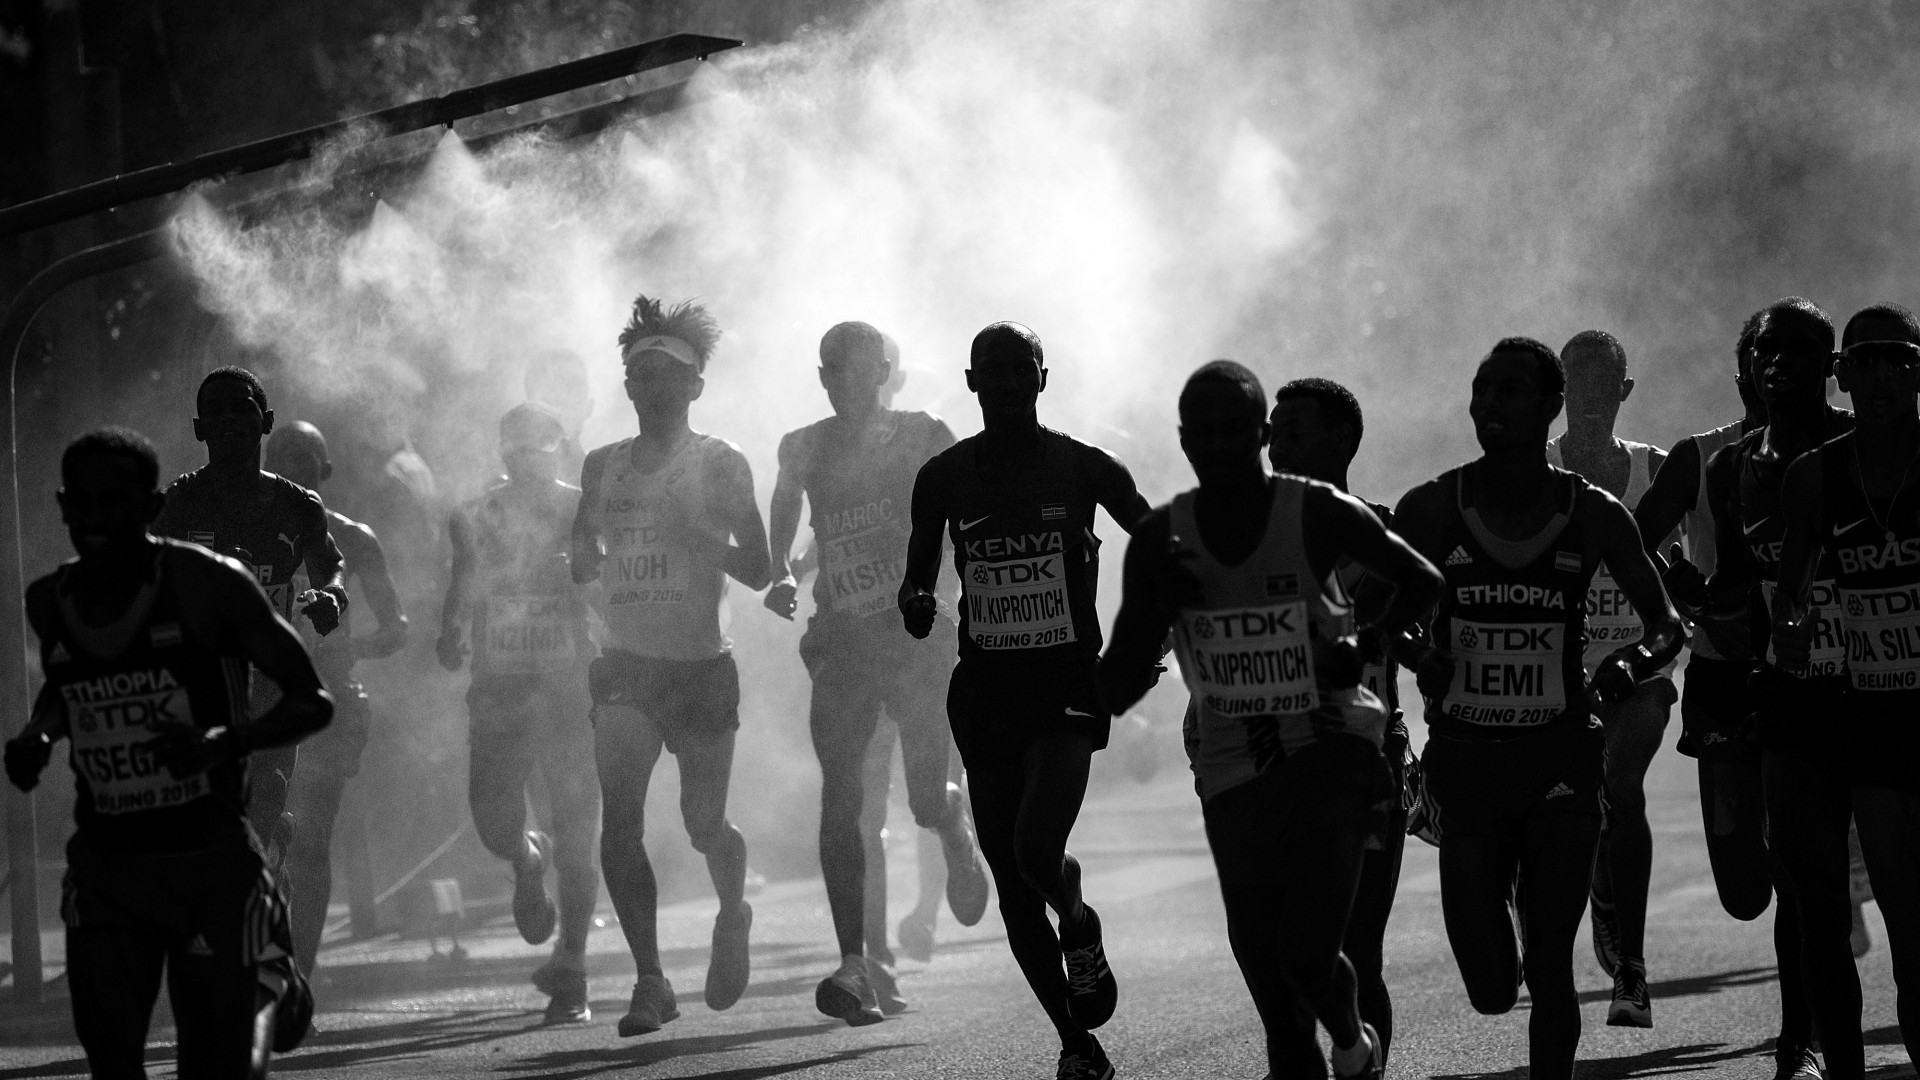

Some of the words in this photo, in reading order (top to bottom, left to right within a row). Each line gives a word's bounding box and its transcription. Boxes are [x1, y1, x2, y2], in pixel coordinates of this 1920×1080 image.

[964, 531, 1063, 559] KENYA
[617, 555, 667, 581] NOH
[987, 559, 1056, 586] TDK
[652, 589, 684, 602] 2015
[1456, 583, 1565, 610] ETHIOPIA
[975, 633, 1031, 648] BEIJING
[1035, 626, 1068, 645] 2015
[1213, 609, 1295, 638] TDK
[490, 624, 567, 652] NZIMA
[1478, 627, 1553, 650] TDK
[1851, 629, 1878, 662] DA
[61, 668, 178, 704] ETHIOPIA
[1464, 660, 1544, 697] LEMI
[1858, 671, 1916, 689] BEIJING
[95, 692, 178, 730] TDK
[1207, 695, 1266, 714] BEIJING
[1271, 692, 1311, 712] 2015
[1450, 704, 1516, 723] BEIJING
[1518, 708, 1558, 724] 2015
